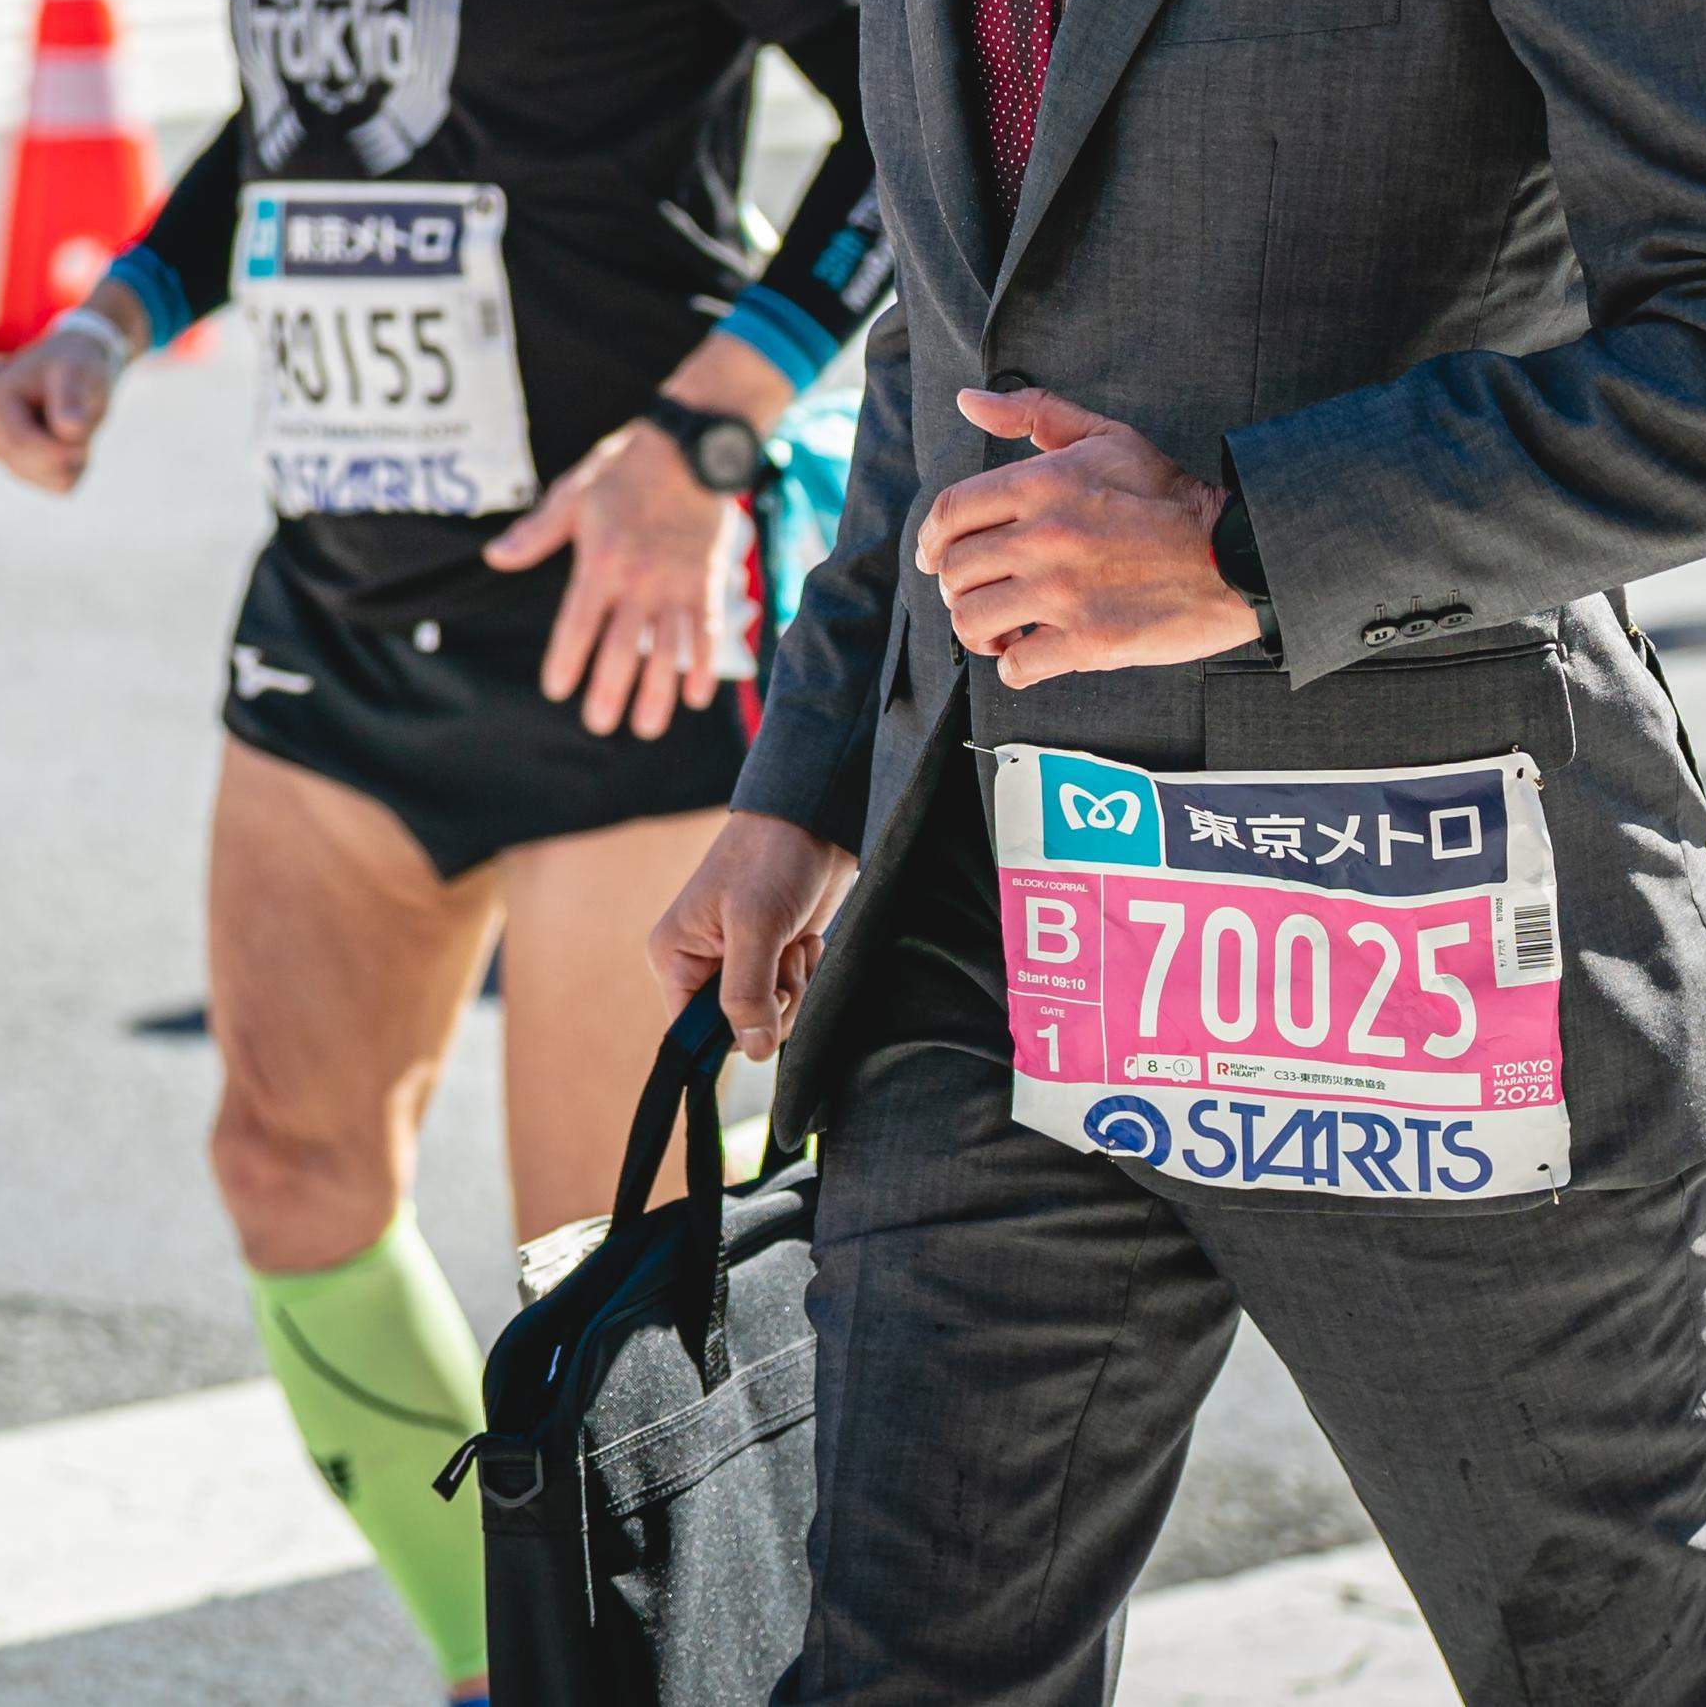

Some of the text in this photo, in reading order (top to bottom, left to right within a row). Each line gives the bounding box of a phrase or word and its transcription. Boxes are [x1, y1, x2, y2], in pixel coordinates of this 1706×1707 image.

[1183, 804, 1483, 866] 東京メトロ
[1025, 895, 1081, 964] B
[1017, 970, 1086, 991] Start 09:10
[1127, 899, 1478, 1060] 70025
[1040, 1005, 1066, 1019] GATE
[1036, 1023, 1061, 1073] 1
[1493, 1059, 1553, 1078] TOKYO
[1493, 1073, 1553, 1087] MARATHON
[1493, 1084, 1554, 1105] 2024
[1182, 1100, 1492, 1192] STARTS
